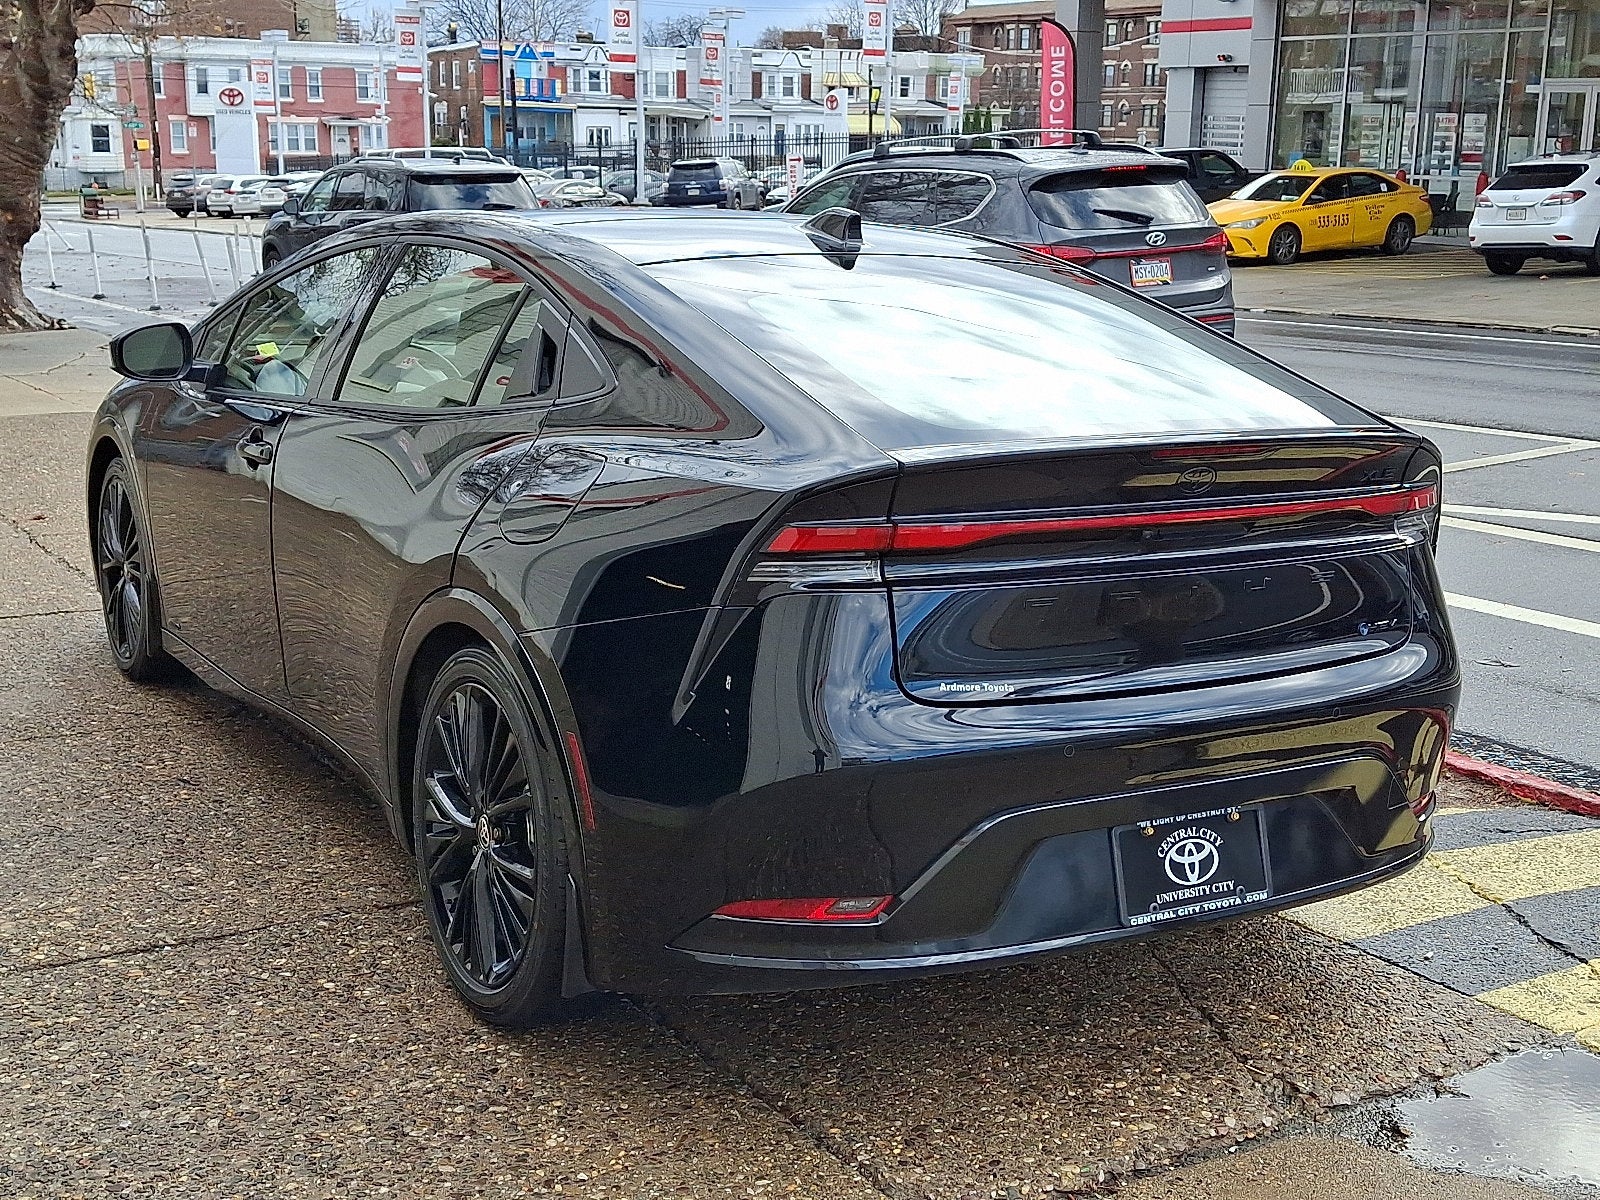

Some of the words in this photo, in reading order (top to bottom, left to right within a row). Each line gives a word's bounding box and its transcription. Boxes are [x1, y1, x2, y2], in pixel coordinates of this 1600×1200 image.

[1317, 213, 1349, 228] 333-3133
[940, 682, 980, 692] Ardmore
[982, 682, 1014, 692] Toyota
[1152, 816, 1174, 826] LIGHT
[1187, 808, 1226, 820] CHESTNUT
[1157, 826, 1199, 858] CENTRAL
[1199, 827, 1224, 847] CITY
[1156, 885, 1210, 904] UNIVERSITY
[1212, 880, 1235, 893] CITY
[1130, 909, 1176, 926] CENTRAL
[1177, 905, 1200, 917] CITY
[1202, 897, 1242, 911] TOYOTA
